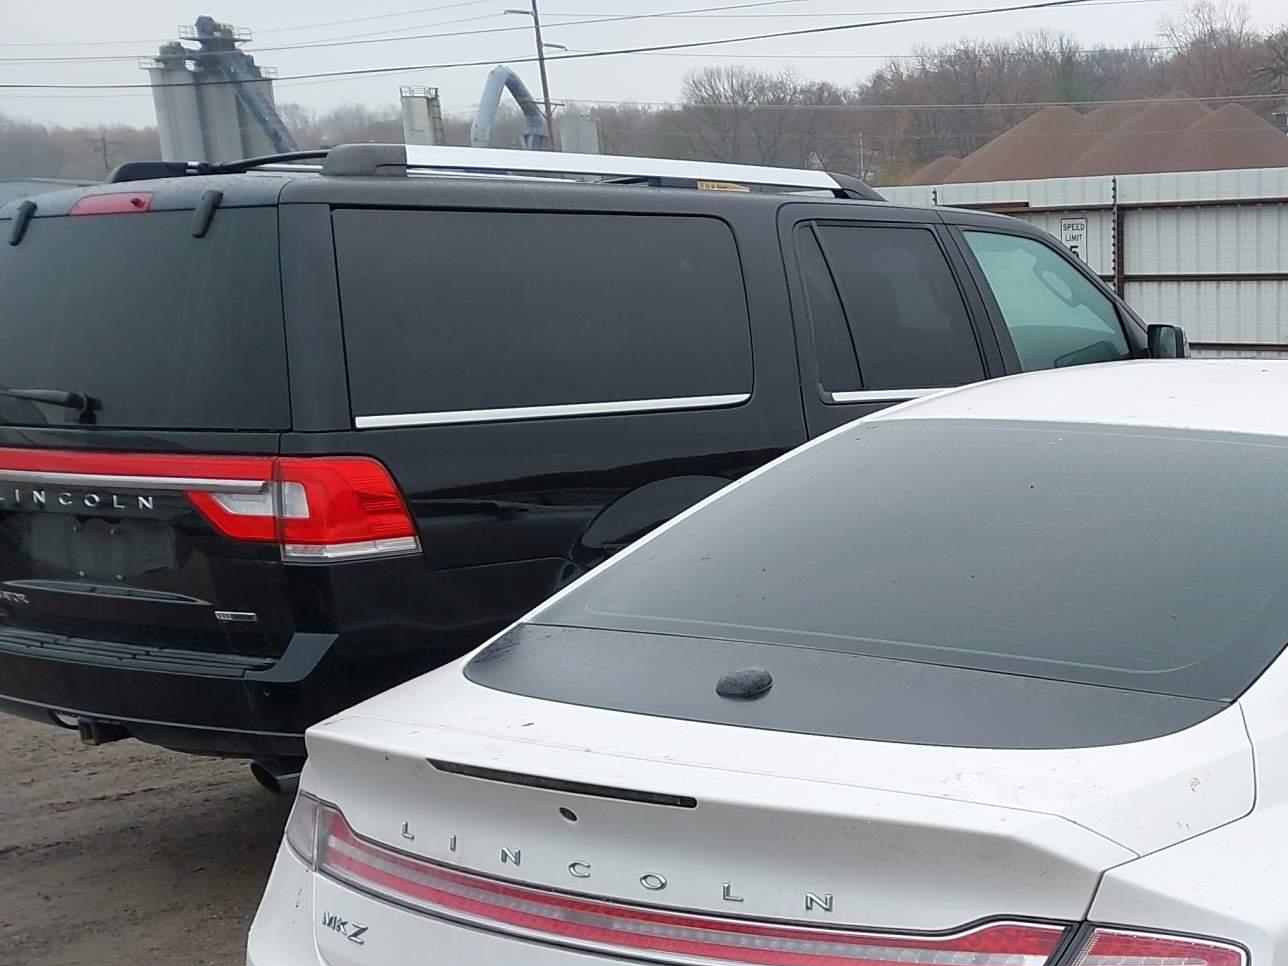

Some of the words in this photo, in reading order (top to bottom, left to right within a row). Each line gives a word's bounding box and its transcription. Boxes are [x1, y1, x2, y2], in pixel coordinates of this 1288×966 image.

[1063, 223, 1085, 231] SPEED
[1065, 234, 1083, 242] LIMIT
[0, 488, 154, 510] INCOLN
[400, 820, 833, 912] LINCOLN
[321, 911, 369, 945] MKZ
